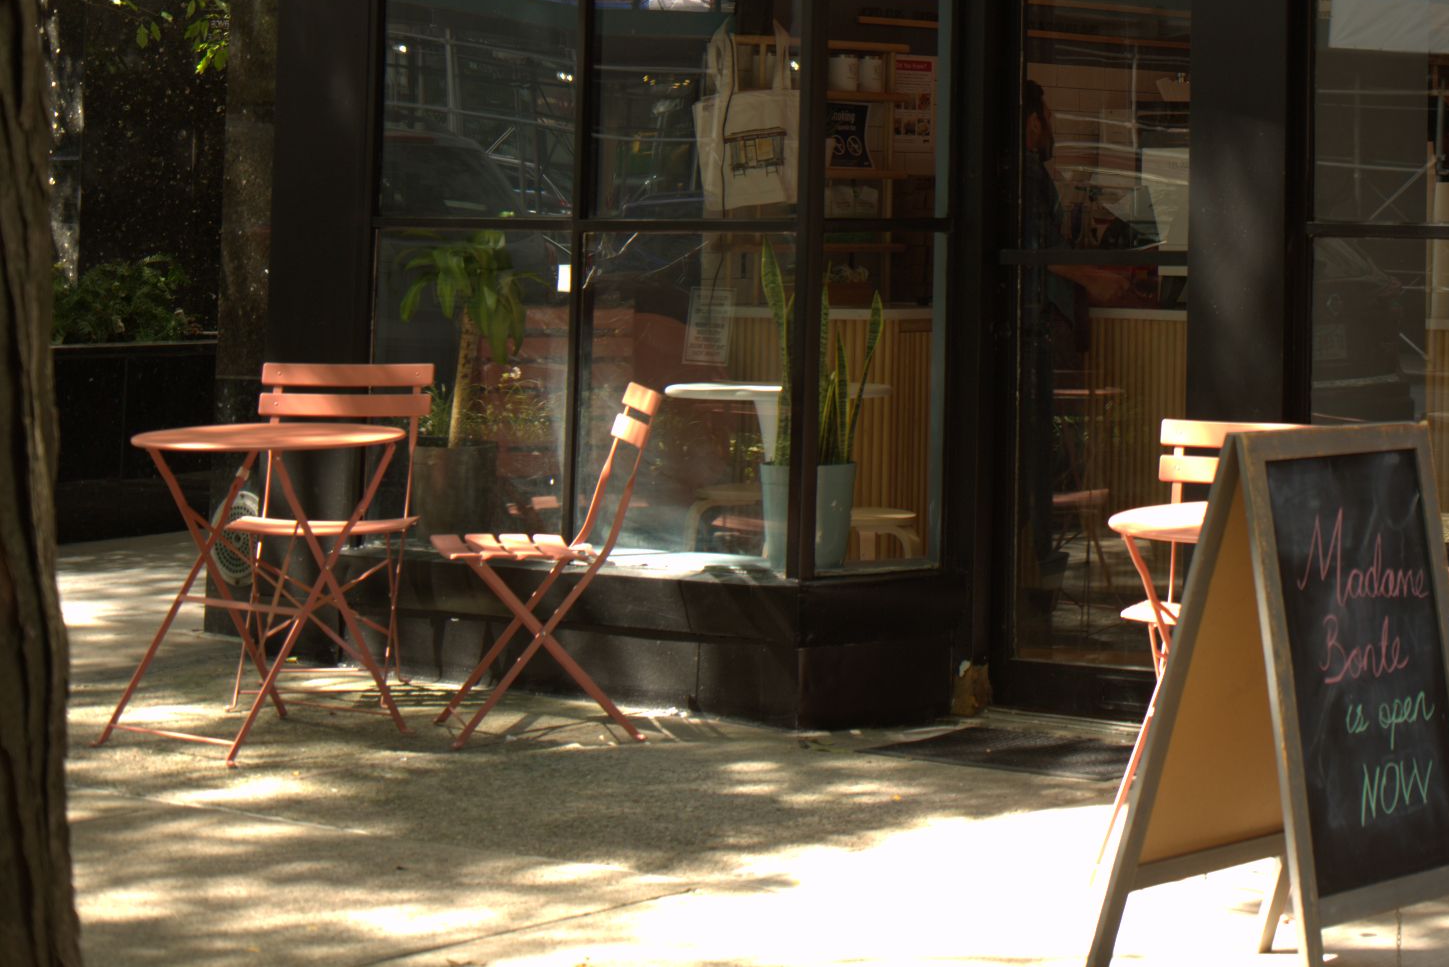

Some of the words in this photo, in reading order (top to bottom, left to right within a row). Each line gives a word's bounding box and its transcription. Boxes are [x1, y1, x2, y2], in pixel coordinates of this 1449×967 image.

[1297, 507, 1429, 607] Madame
[1319, 614, 1409, 684] Bonte
[1345, 703, 1370, 734] is
[1379, 690, 1435, 751] open
[1361, 756, 1433, 828] NOW
